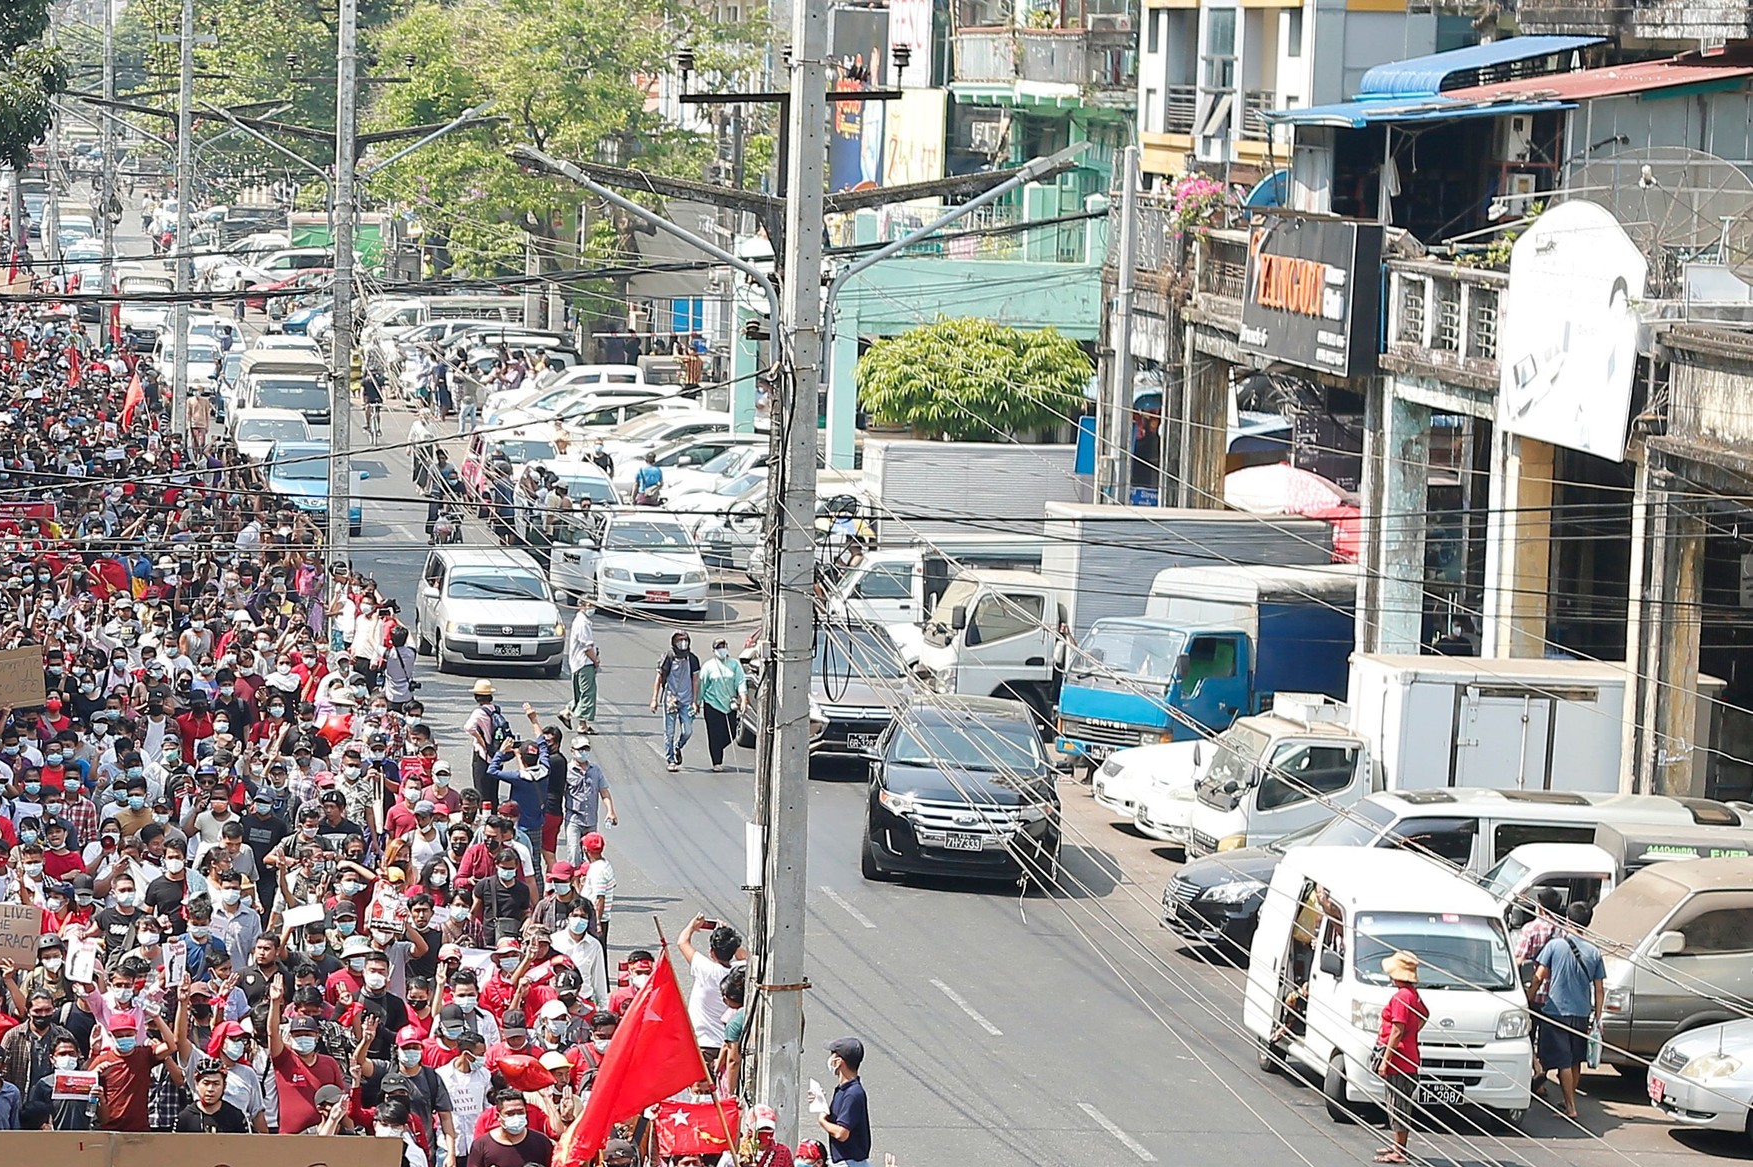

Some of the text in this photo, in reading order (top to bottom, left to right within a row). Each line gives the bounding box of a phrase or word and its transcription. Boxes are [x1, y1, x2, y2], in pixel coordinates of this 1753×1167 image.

[1085, 717, 1128, 730] CANTER
[947, 837, 980, 849] 7H-7333
[4, 906, 33, 919] LIVE
